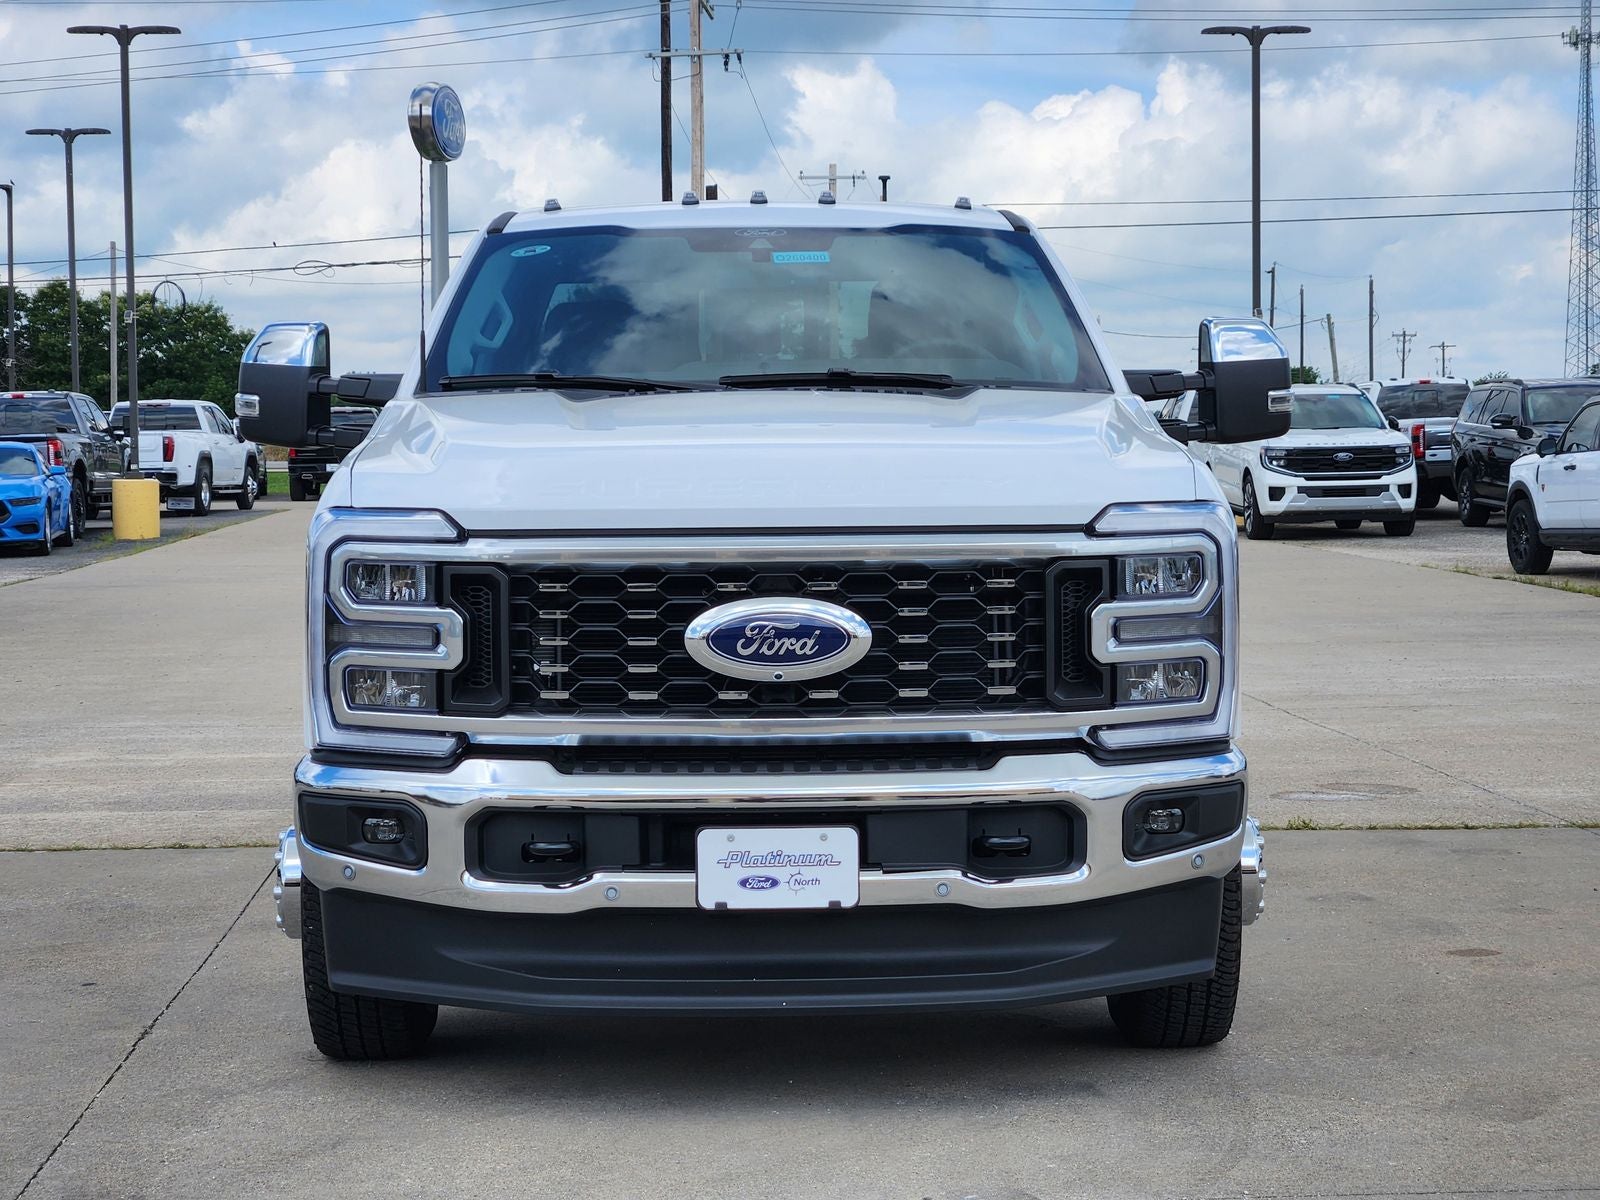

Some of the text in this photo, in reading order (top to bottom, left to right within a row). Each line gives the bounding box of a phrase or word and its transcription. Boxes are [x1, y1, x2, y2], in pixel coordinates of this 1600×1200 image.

[736, 621, 821, 656] Ford
[717, 850, 841, 869] Platinum
[745, 877, 821, 889] Ford North
